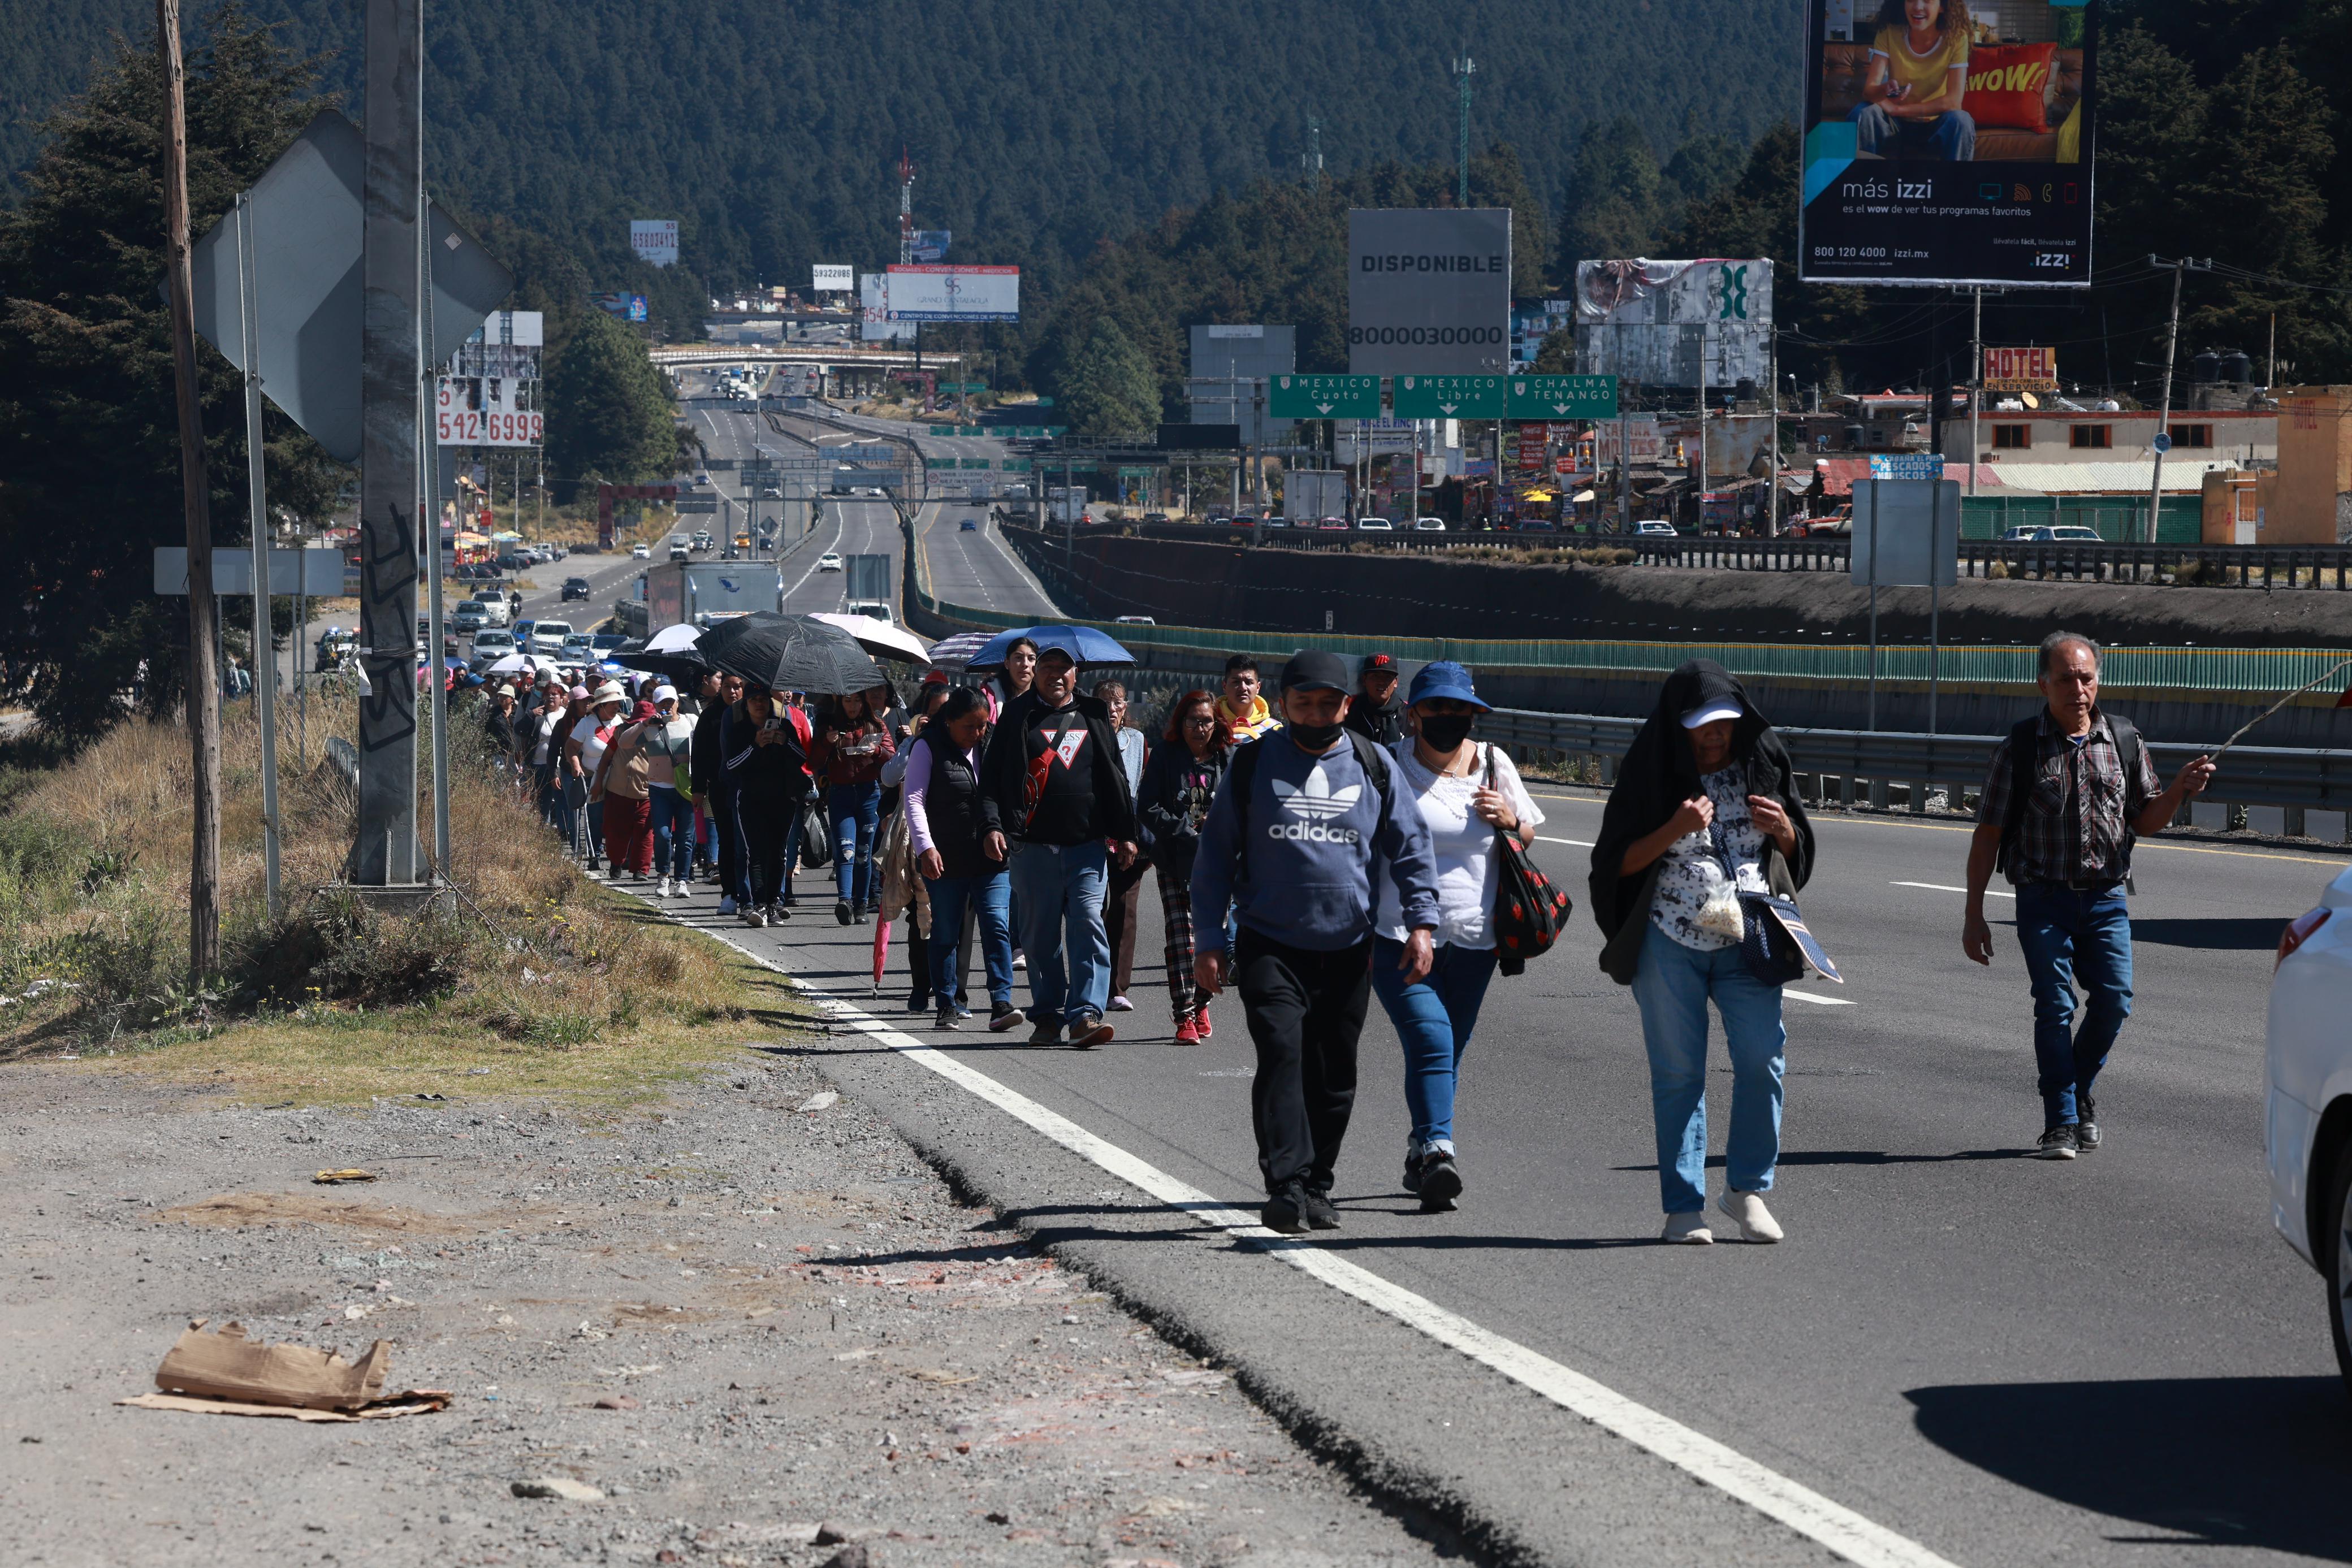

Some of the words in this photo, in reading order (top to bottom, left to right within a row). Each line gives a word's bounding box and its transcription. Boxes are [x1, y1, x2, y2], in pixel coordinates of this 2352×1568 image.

[1843, 177, 1888, 198] más
[1897, 178, 1931, 198] izzi
[1856, 204, 1865, 213] el
[1892, 204, 1902, 213] de
[1923, 205, 1937, 214] tus
[1940, 207, 1989, 216] programas
[1992, 206, 2031, 216] favoritos
[1814, 246, 1834, 257] 800
[1839, 247, 1856, 257] 120
[1860, 247, 1886, 257] 4000
[1894, 249, 1929, 258] izzi.mx
[1362, 255, 1502, 272] DISPONIBLE
[1350, 327, 1502, 345] 8000030000
[1985, 349, 2054, 378] HOTEL
[1300, 379, 1370, 387] MEXICO
[1424, 379, 1494, 387] MEXICO
[1535, 379, 1607, 387] CHALMA
[1311, 390, 1359, 399] Cuota
[1438, 391, 1480, 400] Libre
[1534, 391, 1610, 399] TENANGO
[439, 413, 478, 439] 542
[1382, 417, 1390, 427] EL
[1880, 462, 1931, 471] PESCADOS
[1269, 820, 1359, 843] adidas
